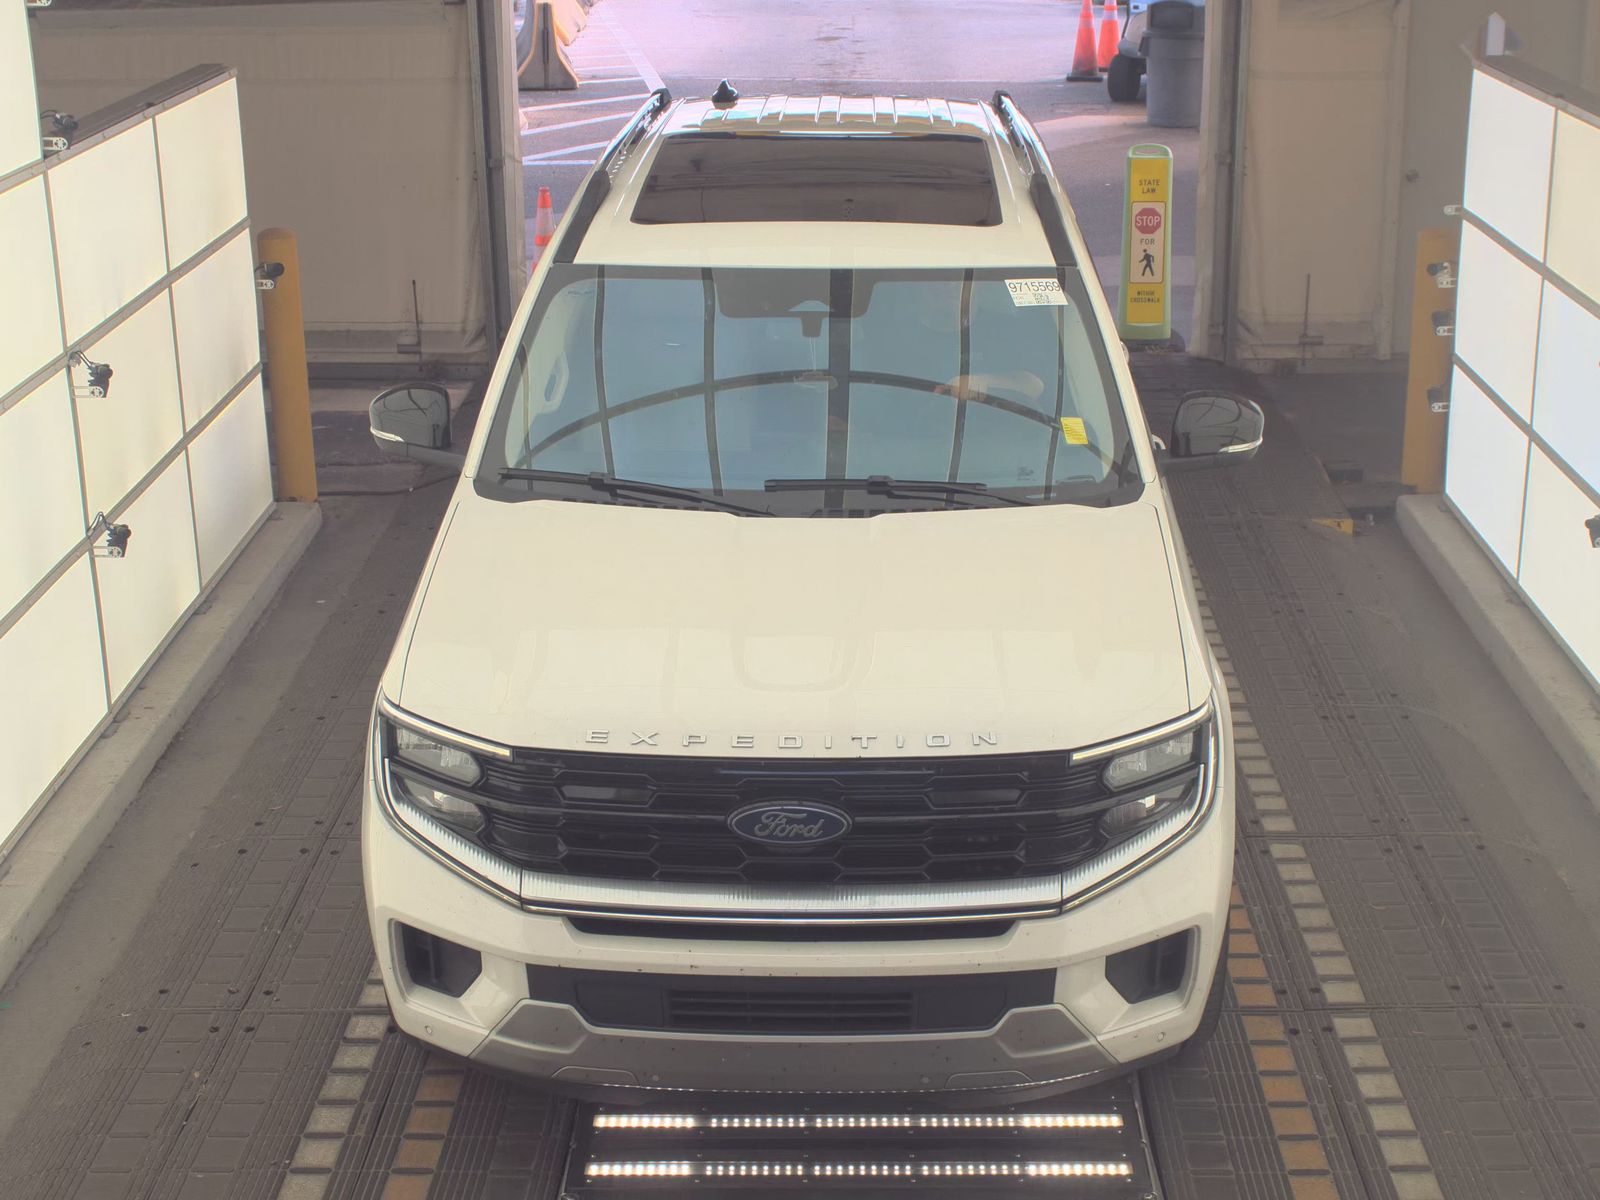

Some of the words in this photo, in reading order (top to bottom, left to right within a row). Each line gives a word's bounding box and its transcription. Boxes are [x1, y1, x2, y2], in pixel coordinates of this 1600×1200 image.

[1138, 178, 1161, 186] STATE
[1136, 215, 1161, 227] STOP
[1140, 238, 1156, 246] FOR
[1008, 281, 1062, 293] 9715569
[584, 728, 999, 750] EXPEDITION
[753, 810, 825, 839] Ford
